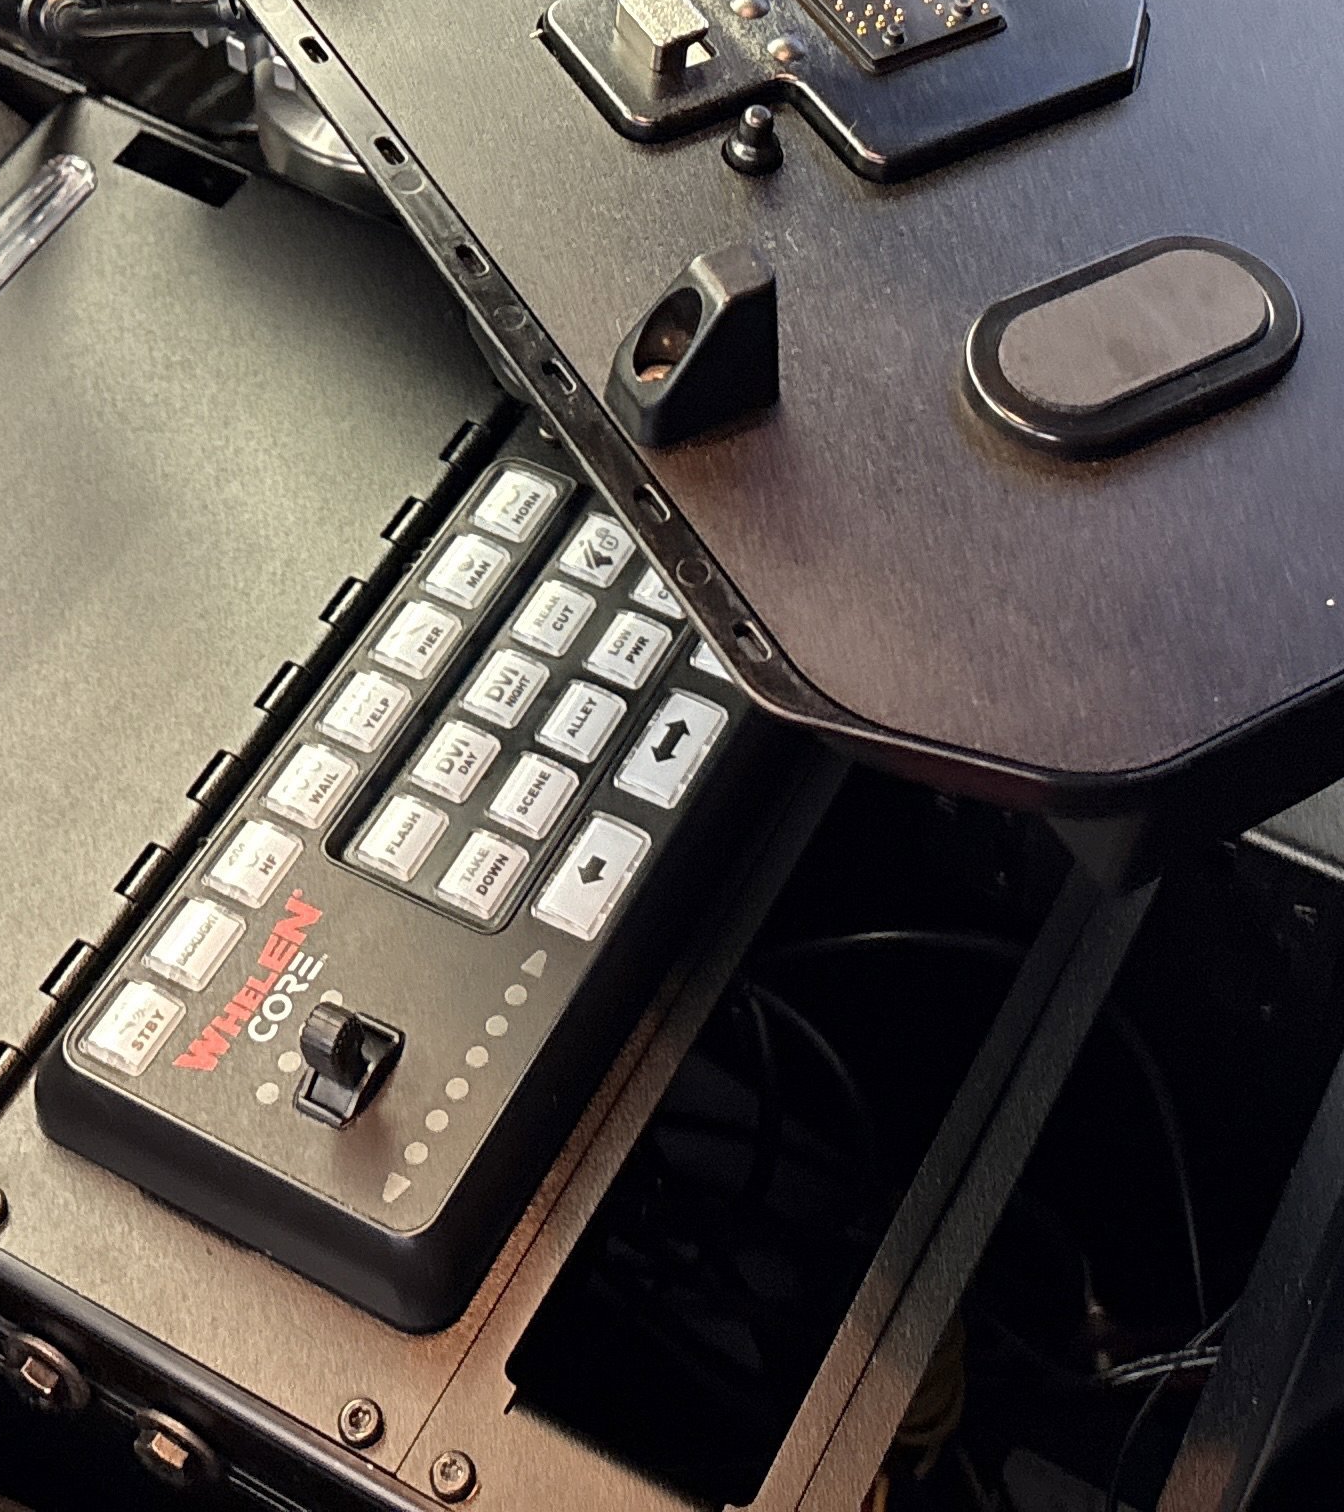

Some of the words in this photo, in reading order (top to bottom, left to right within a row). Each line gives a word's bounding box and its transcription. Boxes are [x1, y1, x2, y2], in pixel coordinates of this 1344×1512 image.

[511, 492, 541, 525] HORN
[465, 559, 491, 590] MAN
[534, 593, 561, 628] REAR
[551, 604, 575, 632] CUT
[418, 626, 444, 656] PIER
[608, 627, 633, 656] LOW
[625, 635, 650, 664] PWR
[504, 674, 531, 708] NIGHT
[362, 697, 392, 730] YELP
[565, 697, 599, 739] ALLEY
[457, 750, 480, 777] DAY
[307, 770, 340, 806] WAIL
[516, 770, 552, 817] SCENE
[385, 811, 422, 856] FLASH
[259, 854, 277, 875] HF
[460, 847, 491, 884] TAKE
[476, 853, 510, 897] DOWN
[176, 915, 219, 966] BACKLIGHT
[172, 890, 323, 1072] WHELEN
[248, 951, 325, 1042] CORE
[131, 1009, 165, 1052] STBY
